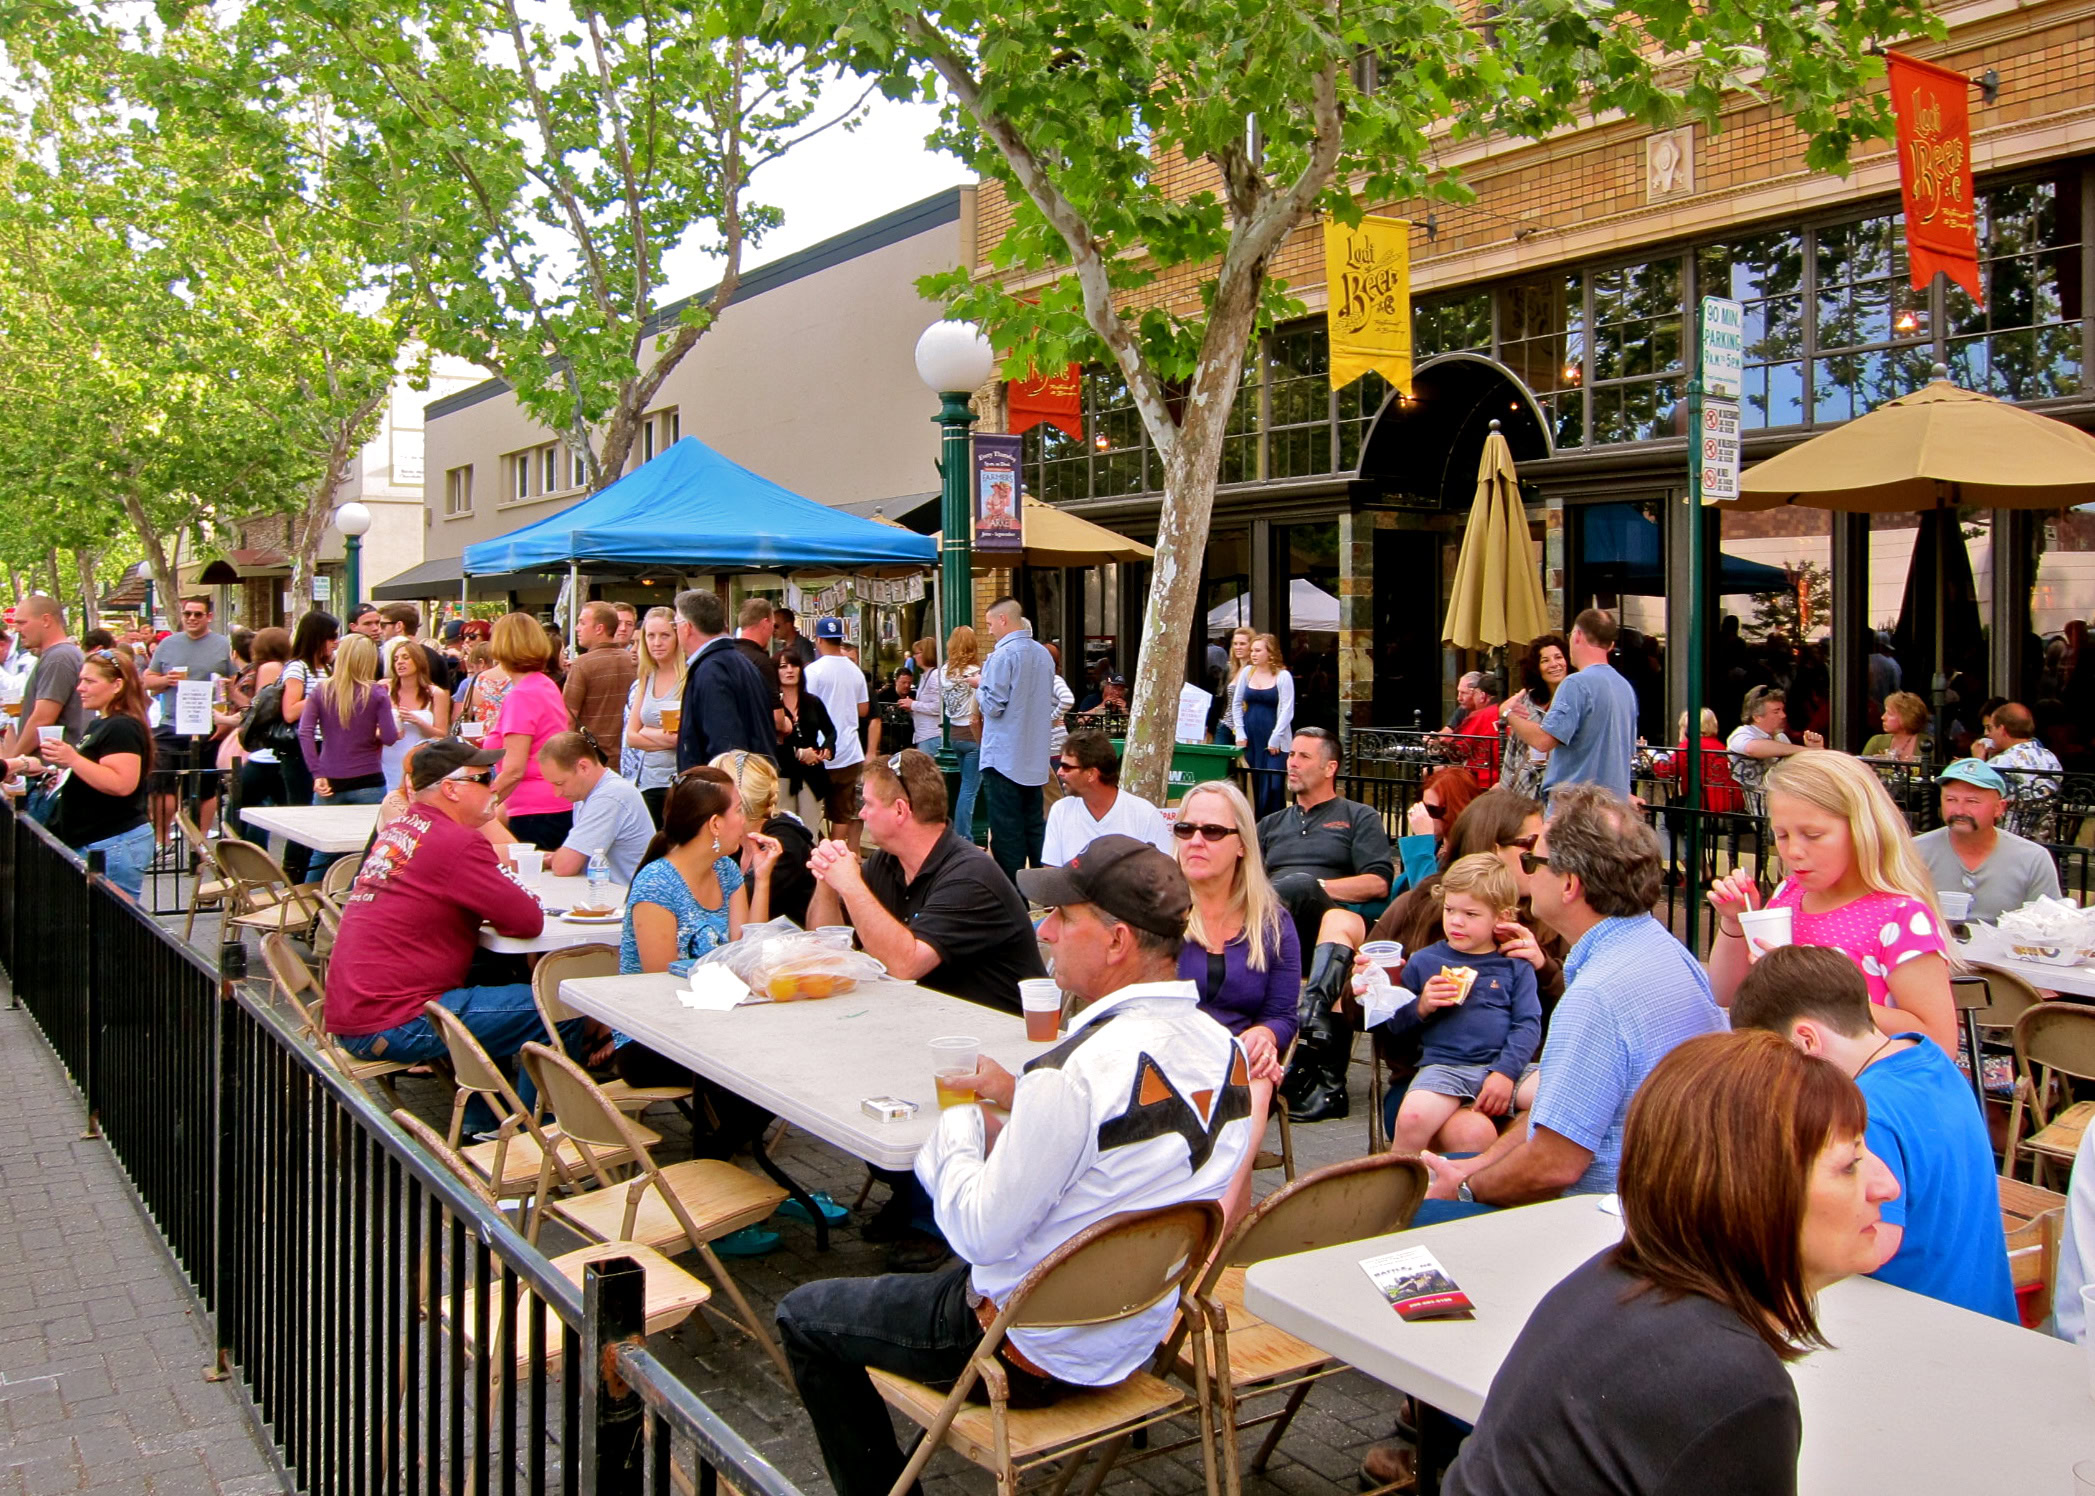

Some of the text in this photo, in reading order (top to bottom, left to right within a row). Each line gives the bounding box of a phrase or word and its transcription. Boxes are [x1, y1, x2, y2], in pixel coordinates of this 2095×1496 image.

[1912, 87, 1941, 138] Lodi
[1909, 138, 1964, 225] Beer
[1346, 234, 1375, 269] Lodi
[1338, 267, 1399, 334] Beer
[1707, 304, 1719, 322] 90
[1704, 329, 1741, 351] PARKING
[982, 474, 1014, 483] FARMERS
[1168, 770, 1195, 783] WM
